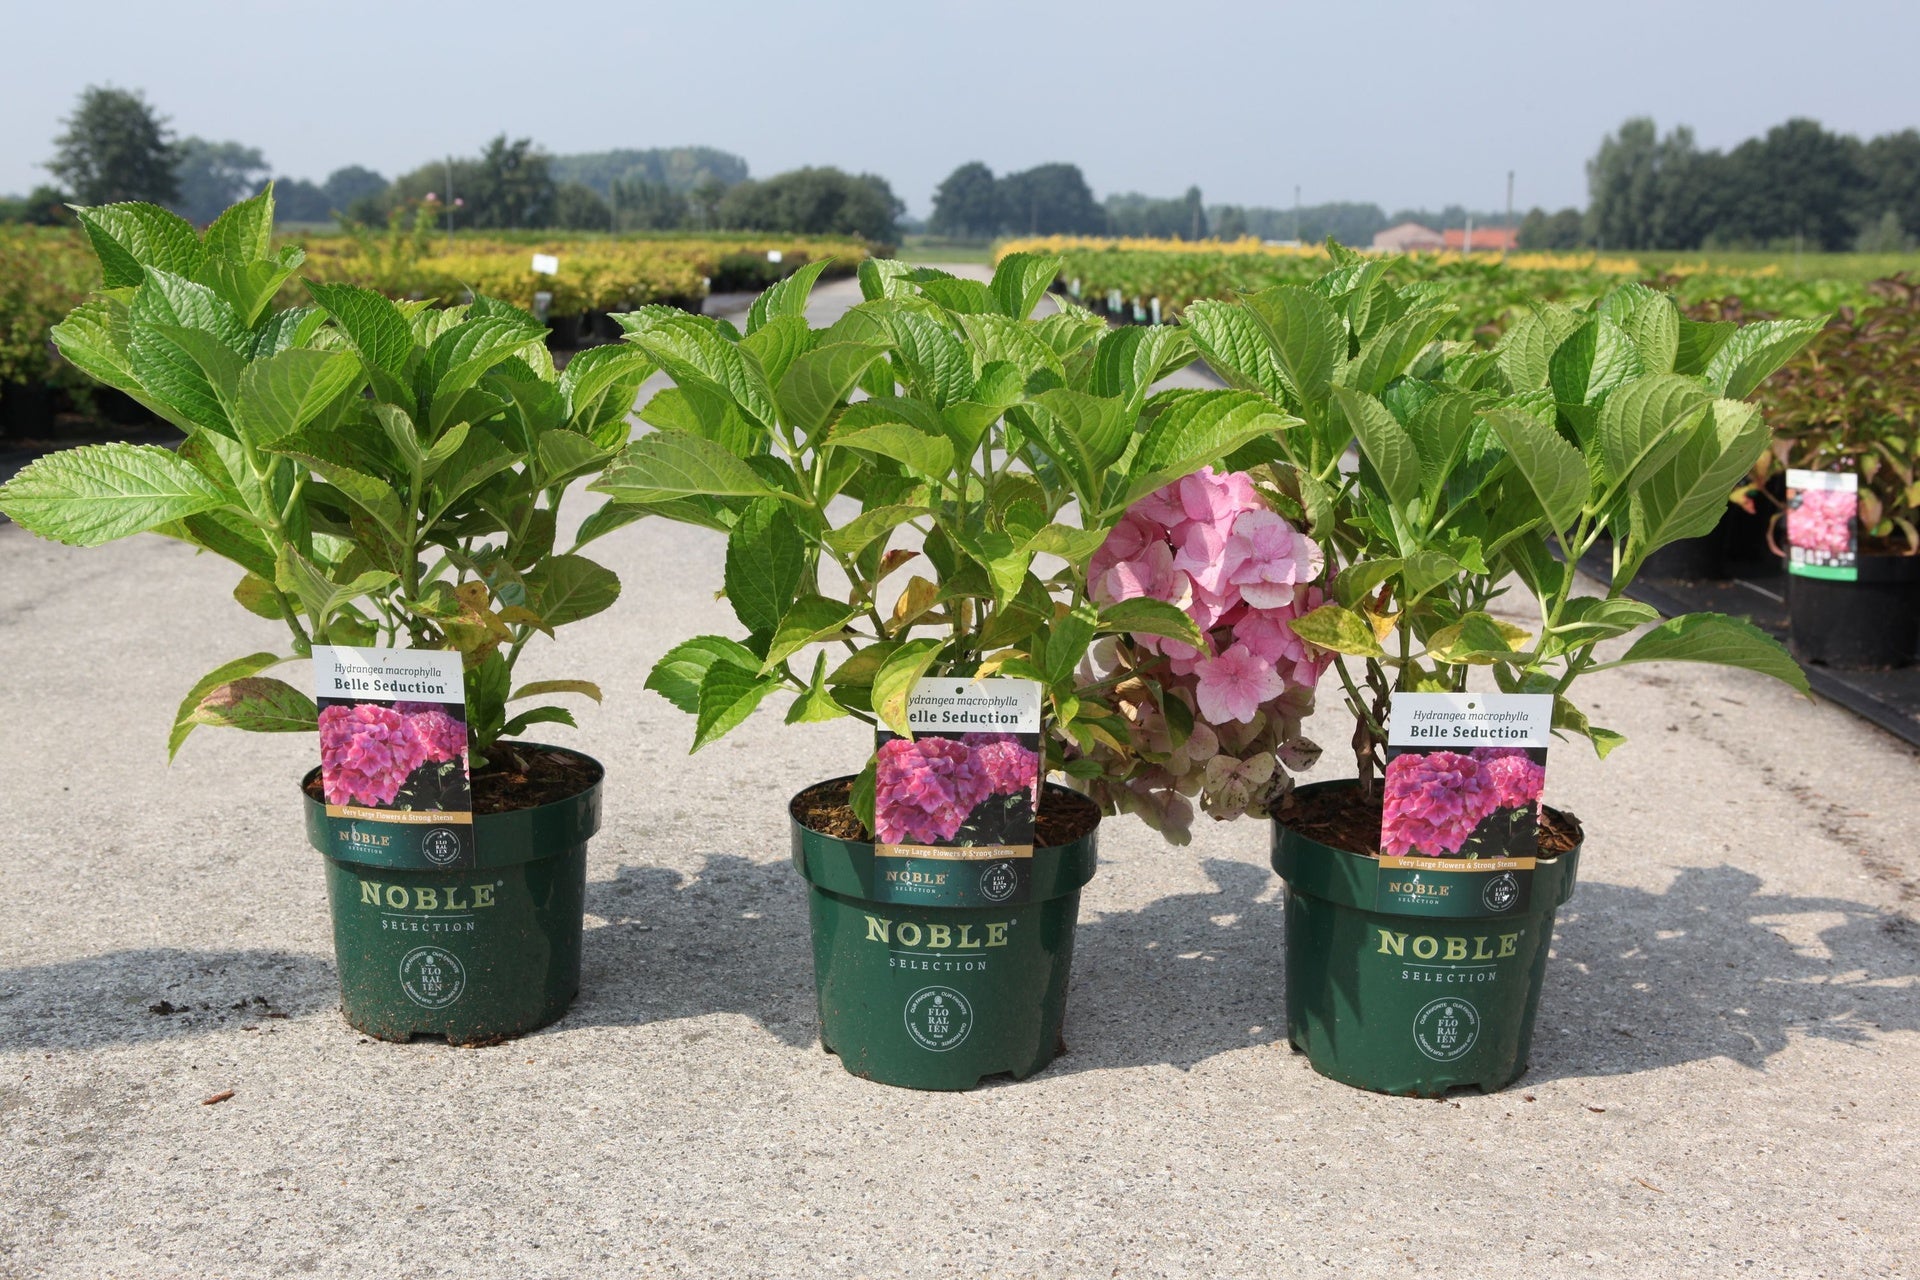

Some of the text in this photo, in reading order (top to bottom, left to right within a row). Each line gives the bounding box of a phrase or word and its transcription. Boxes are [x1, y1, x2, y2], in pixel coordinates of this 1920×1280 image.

[335, 663, 441, 679] Hydrangea macrophylla
[334, 678, 445, 695] Belle Seduction
[908, 694, 1018, 709] ydrangea macrophylla
[909, 710, 1019, 725] elle Seduction
[1413, 710, 1529, 723] Hydrangea macrophylla
[1410, 725, 1529, 739] Belle Seduction
[342, 808, 357, 817] Very
[358, 809, 374, 819] Large
[376, 811, 400, 821] Flowers
[409, 814, 432, 823] Strong
[338, 831, 390, 846] NOBLE
[893, 847, 910, 856] Very
[912, 848, 931, 857] Large
[933, 849, 960, 857] Flowers
[969, 850, 992, 858] Strong
[1398, 859, 1414, 868] Very
[1416, 859, 1436, 869] Large
[1438, 860, 1465, 869] Flowers
[1473, 861, 1496, 870] Strong
[1497, 860, 1517, 868] Stems
[886, 871, 946, 885] NOBLE
[359, 880, 495, 910] NOBLE
[896, 886, 936, 894] SELECTION
[1388, 882, 1450, 896] NOBLE
[1398, 897, 1440, 905] SELECTION
[382, 919, 475, 932] SELECTION
[864, 915, 1008, 948] NOBLE
[1377, 929, 1518, 960] NOBLE
[421, 967, 441, 975] FLO
[889, 958, 987, 971] SELECTION
[1402, 970, 1497, 983] SELECTION
[928, 1008, 949, 1016] FLO
[928, 1016, 949, 1025] RAL
[1438, 1019, 1458, 1027] FLO
[1437, 1027, 1457, 1035] RAL
